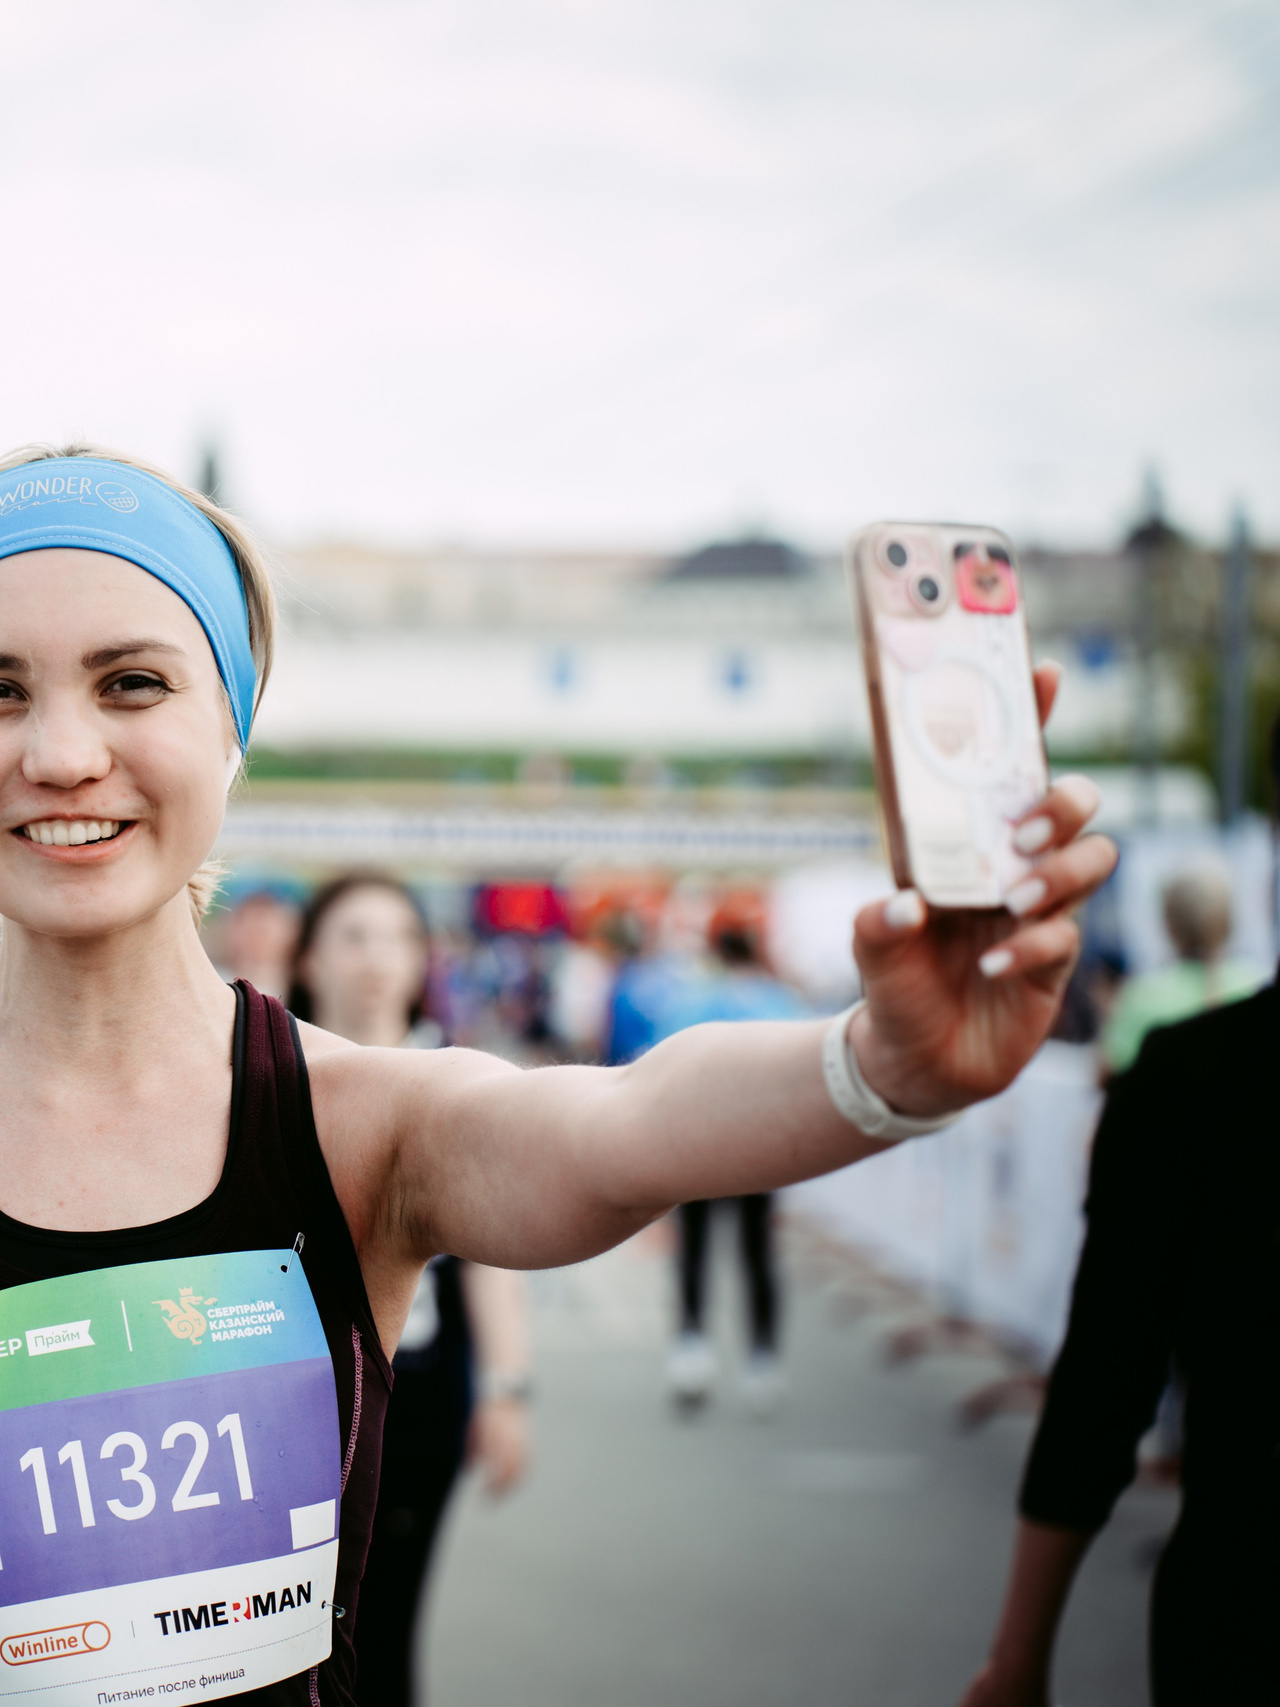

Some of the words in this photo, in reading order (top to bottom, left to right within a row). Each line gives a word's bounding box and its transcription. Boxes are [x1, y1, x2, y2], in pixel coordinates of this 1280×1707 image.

[207, 1300, 276, 1319] СБЕРПРАЙМ
[209, 1309, 285, 1331] КАЗАНСКИЙ
[34, 1330, 80, 1349] Прайм
[211, 1325, 272, 1342] МАРАФОН
[19, 1413, 254, 1535] 11321
[154, 1580, 312, 1636] TIMERMAN
[8, 1633, 79, 1659] Winline
[97, 1686, 155, 1705] Питание
[158, 1678, 196, 1694] после
[199, 1668, 245, 1688] финиша
